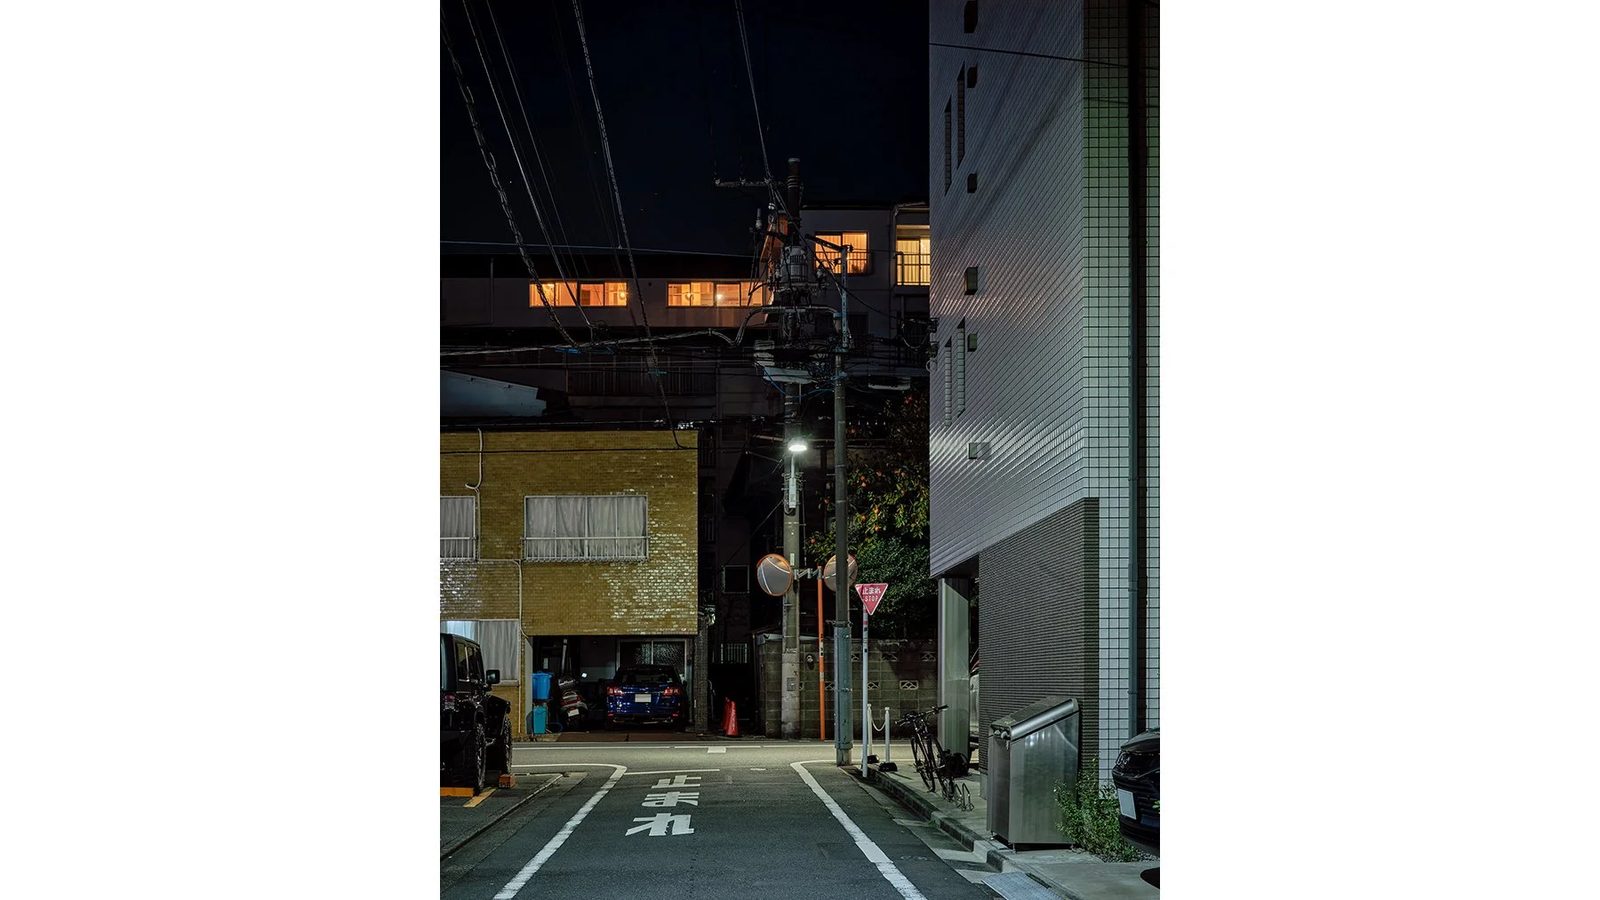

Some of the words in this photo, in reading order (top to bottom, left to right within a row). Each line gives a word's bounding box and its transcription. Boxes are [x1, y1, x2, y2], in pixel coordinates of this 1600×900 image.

[862, 587, 881, 595] 止まれ
[625, 774, 702, 837] 止まれ
